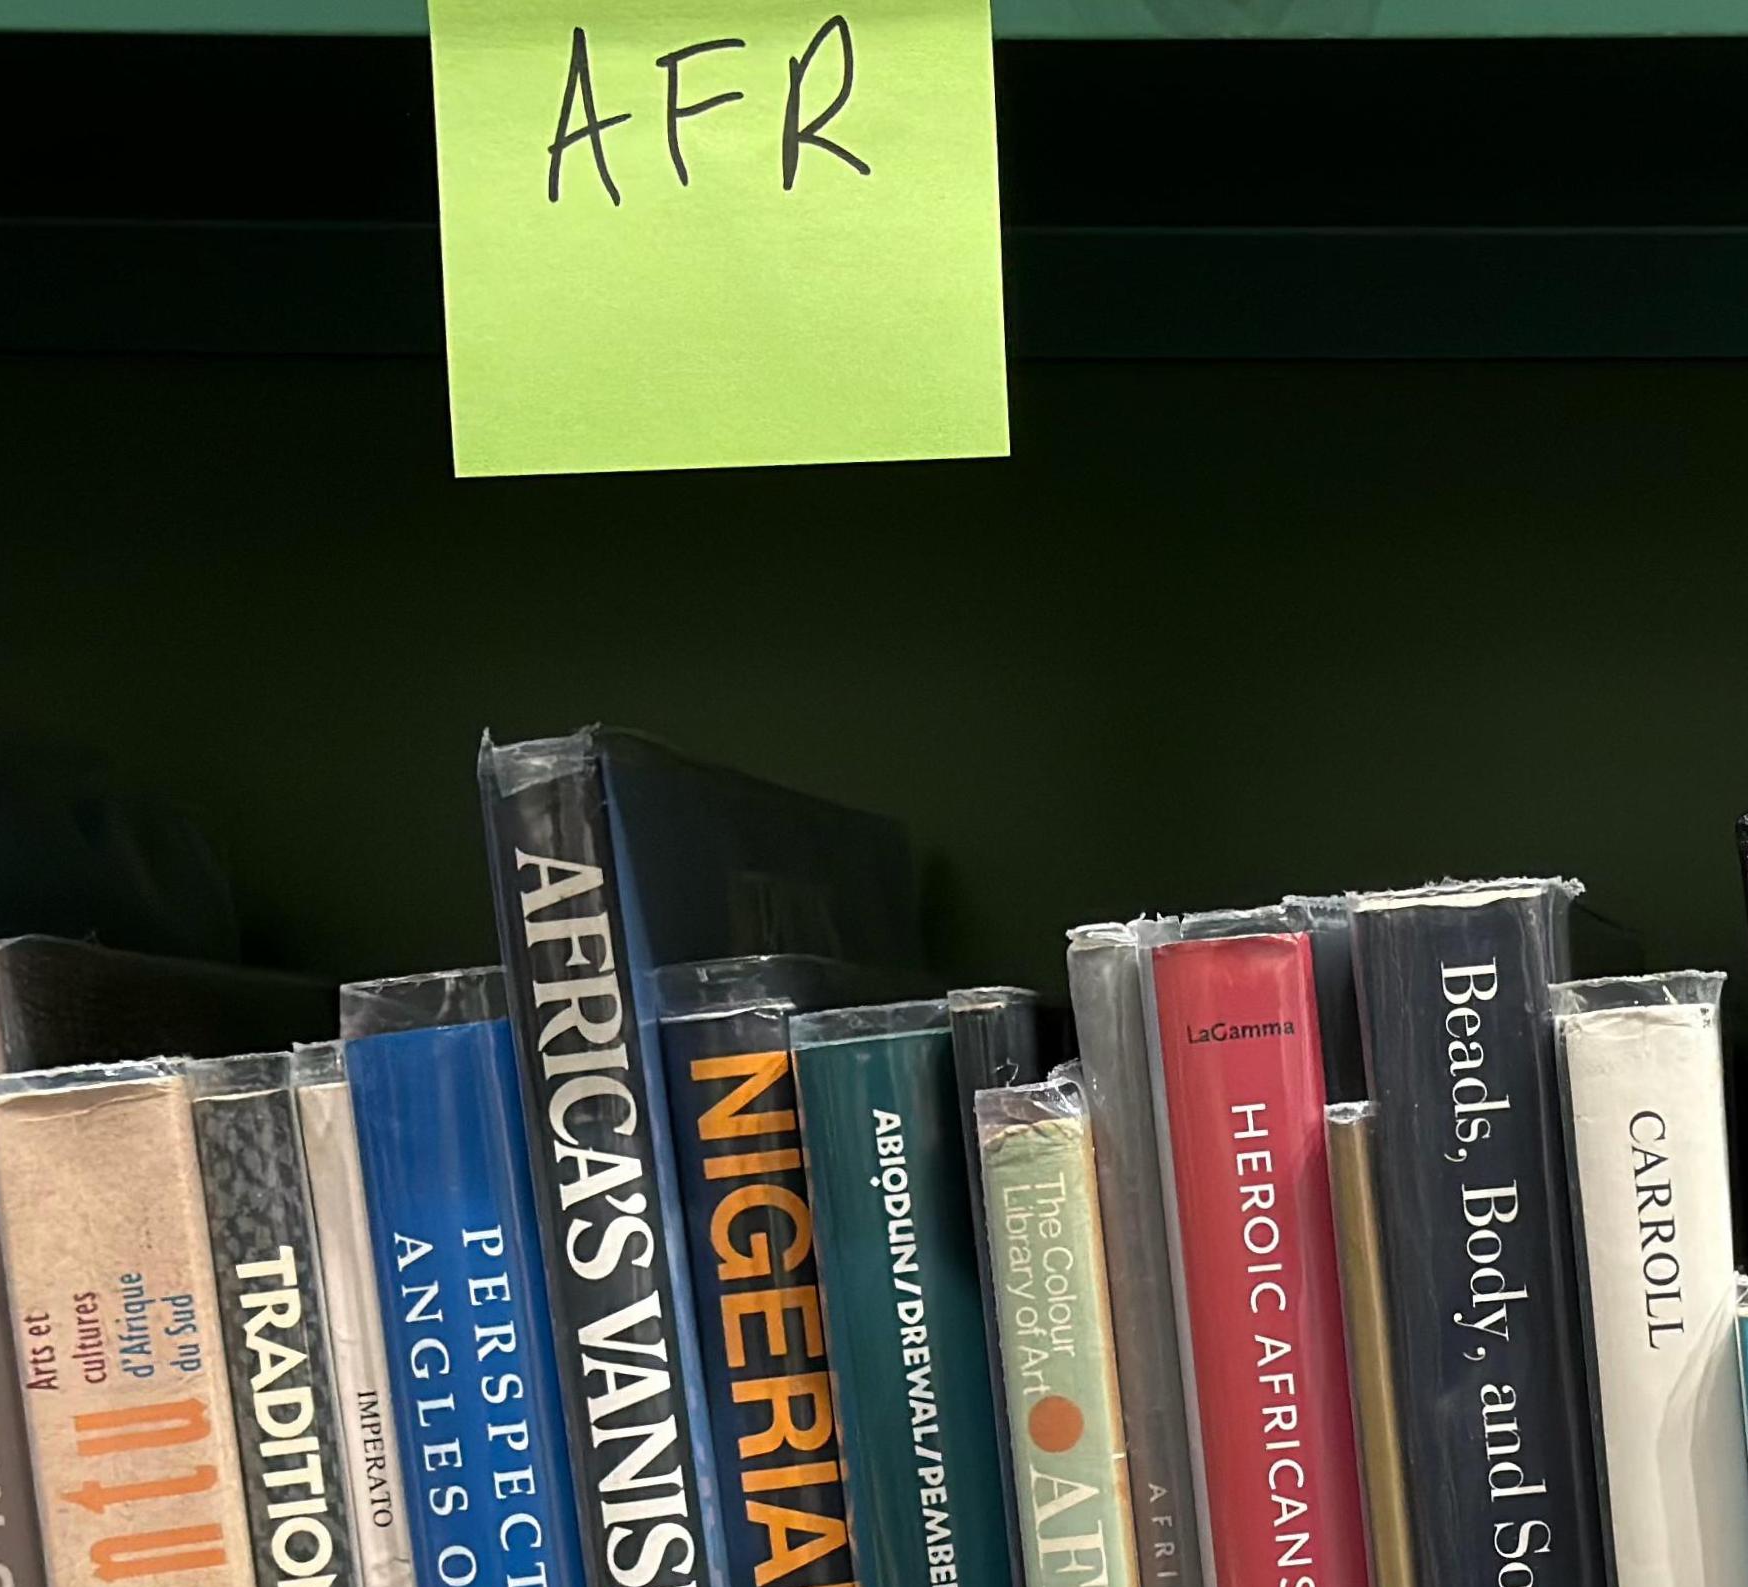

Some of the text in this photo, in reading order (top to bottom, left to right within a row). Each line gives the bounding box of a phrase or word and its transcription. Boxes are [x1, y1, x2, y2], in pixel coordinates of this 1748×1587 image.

[548, 14, 871, 206] AFR
[514, 847, 655, 1282] AFRICA'S
[1186, 1020, 1296, 1045] LaGamma
[1439, 959, 1512, 1164] Beads,
[1230, 1101, 1288, 1315] HEROIC
[1452, 1180, 1530, 1362] Body,
[1627, 1109, 1686, 1350] CARROLL
[356, 1390, 393, 1529] IMPERATO
[393, 1231, 469, 1518] ANGLES
[1480, 1382, 1548, 1502] and
